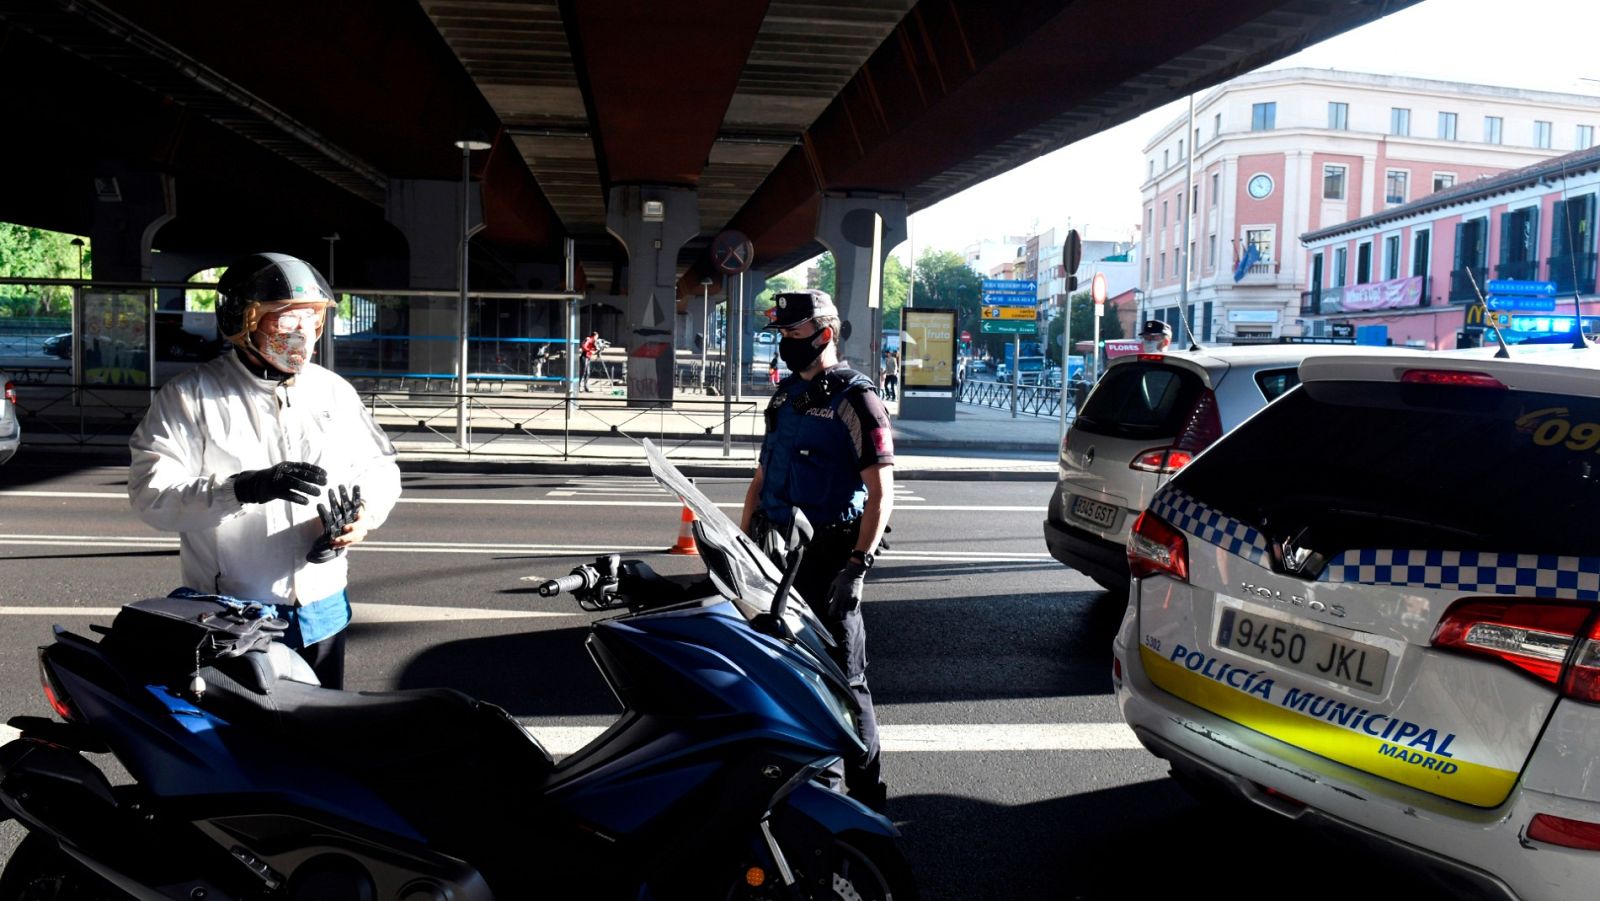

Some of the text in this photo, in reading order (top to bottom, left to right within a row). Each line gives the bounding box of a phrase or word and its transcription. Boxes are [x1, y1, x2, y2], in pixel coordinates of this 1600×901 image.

[1094, 505, 1114, 523] GST
[1240, 581, 1347, 618] KOLEOS
[1236, 618, 1373, 687] 9450 JKL
[1170, 644, 1456, 758] POLICÍA MUNICIPAL
[1378, 743, 1458, 775] MADRID
